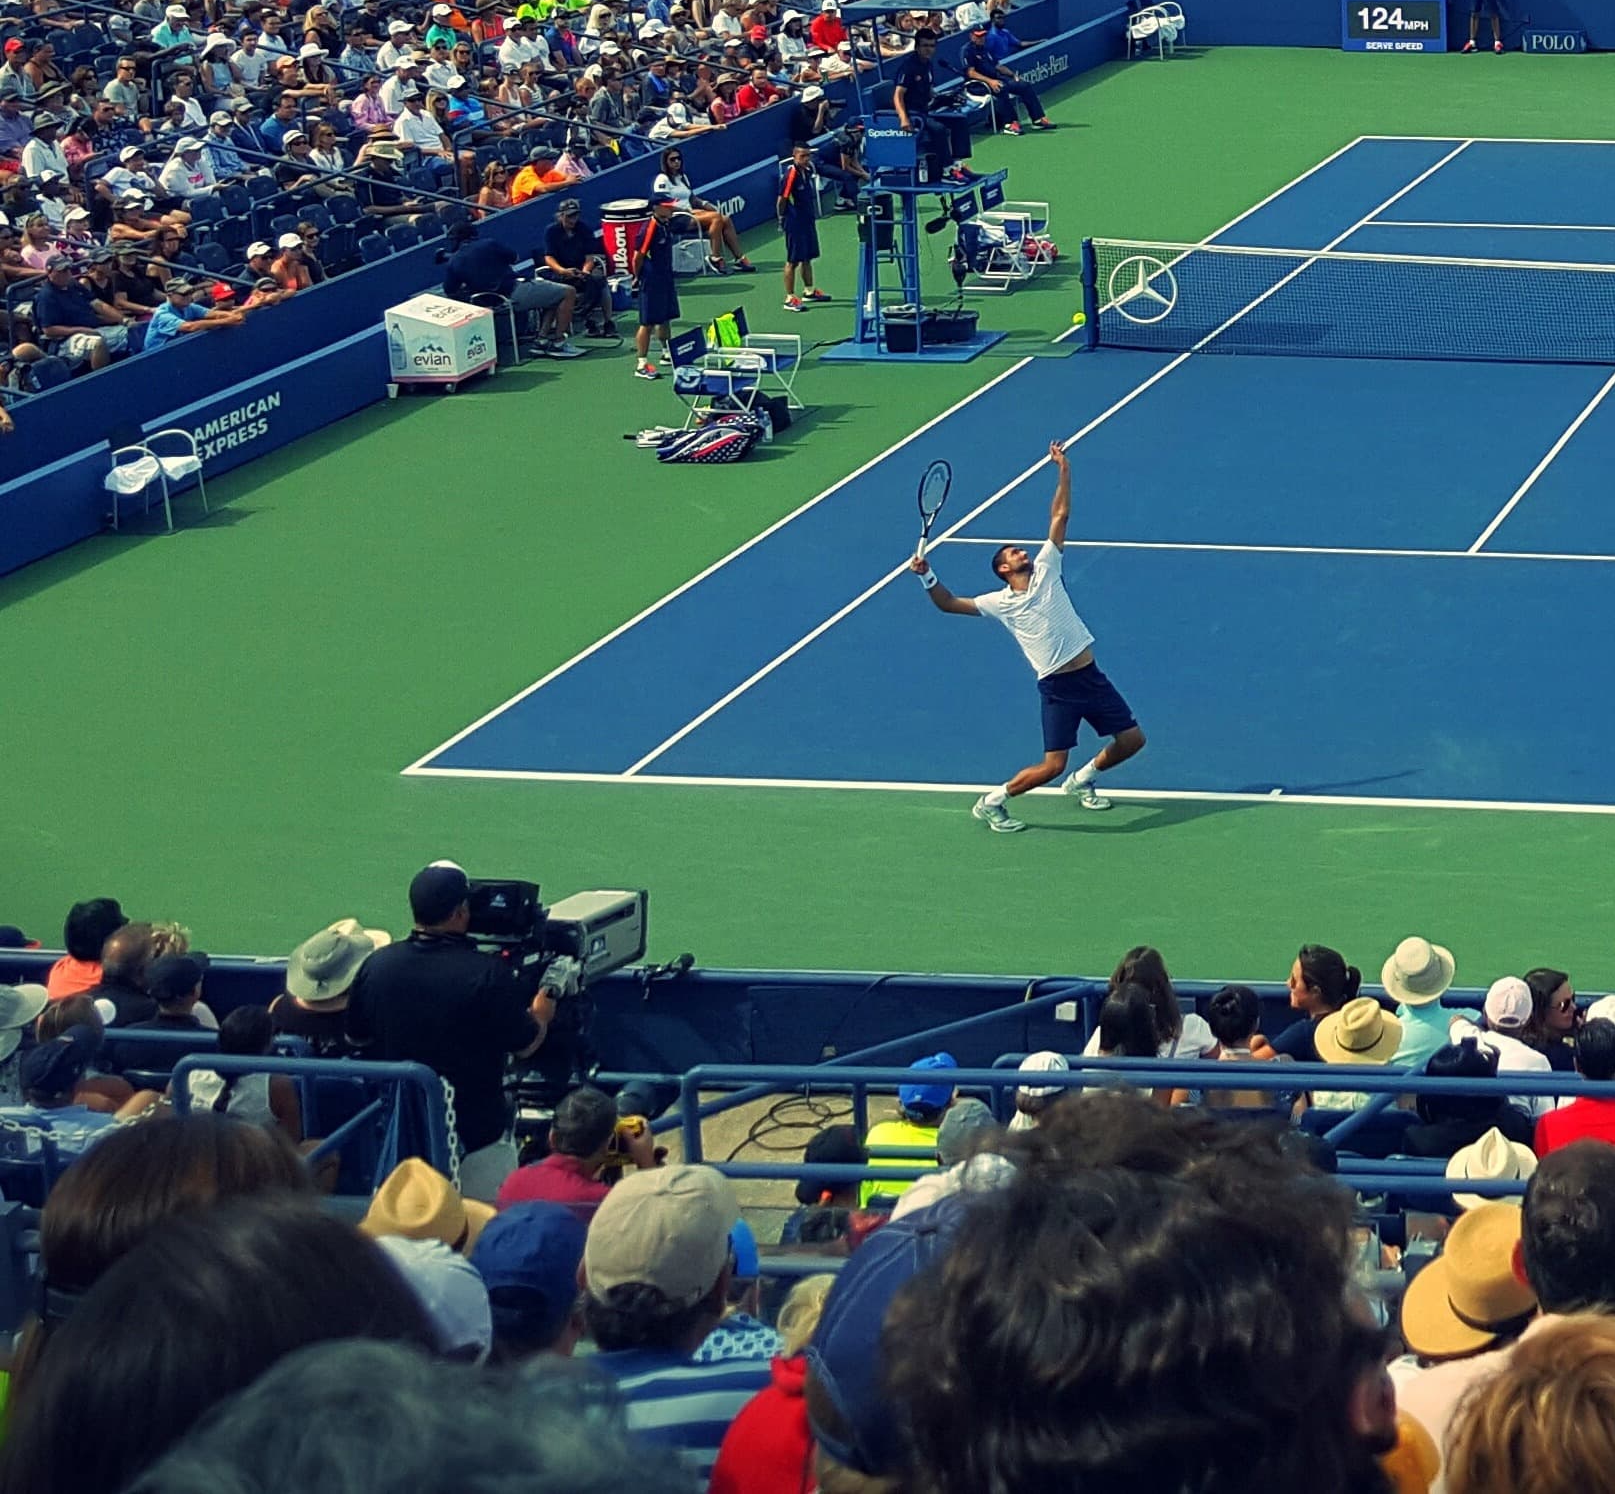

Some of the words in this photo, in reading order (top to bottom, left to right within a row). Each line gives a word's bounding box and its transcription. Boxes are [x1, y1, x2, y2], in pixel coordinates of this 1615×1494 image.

[1531, 33, 1576, 52] POLO
[414, 353, 452, 366] evian
[194, 392, 281, 442] AMERICAN
[196, 418, 268, 462] EXPRESS
